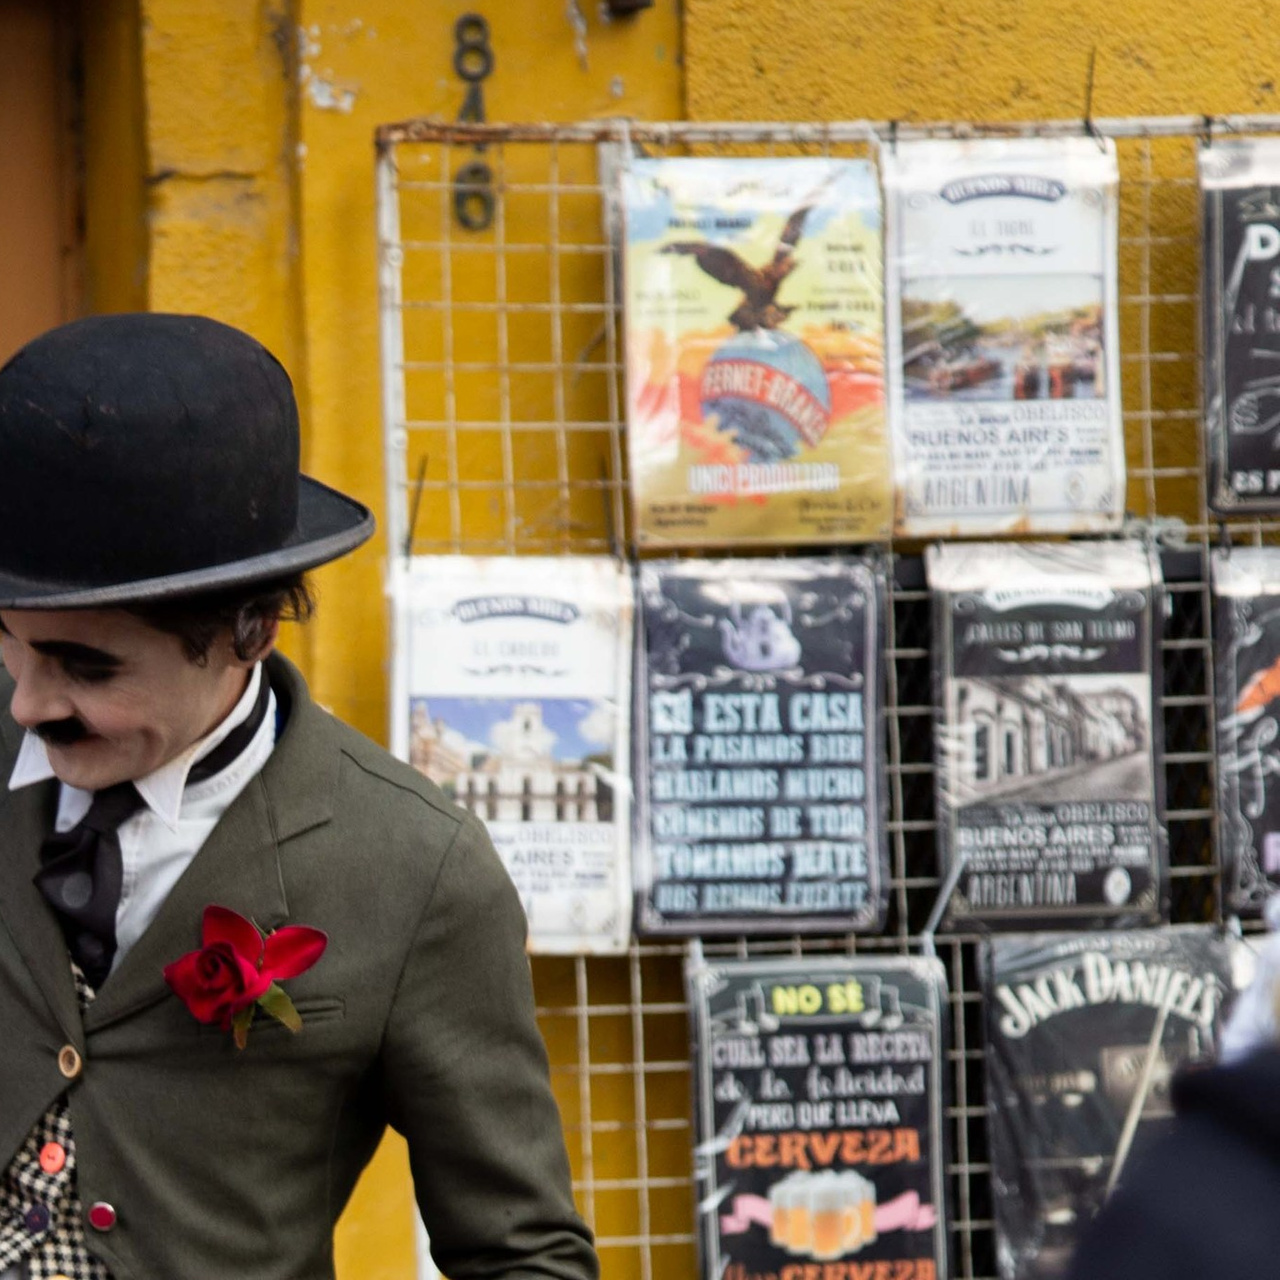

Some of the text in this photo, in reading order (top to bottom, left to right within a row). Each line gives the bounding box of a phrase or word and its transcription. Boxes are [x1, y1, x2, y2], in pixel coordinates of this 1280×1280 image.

[910, 427, 1001, 447] BUENOS
[1007, 426, 1070, 445] AIRES
[923, 476, 1033, 508] ARGENTINA
[703, 693, 782, 732] ESTA
[790, 692, 864, 732] CASA
[653, 734, 864, 763] LA PASAMOS BIEN
[653, 768, 865, 799] HABLAMOS MUCHO
[654, 804, 865, 838] COMEMOS DE TODO
[1056, 803, 1150, 823] OBELISCO
[957, 825, 1047, 847] BUENOS
[1048, 823, 1115, 846] AIRES
[512, 850, 573, 865] AIRES
[656, 843, 786, 879] TOMAMOS
[792, 842, 868, 878] MATE
[656, 883, 698, 913] NOS
[787, 881, 869, 910] FUERTE
[968, 872, 1077, 907] ARGENTINA
[772, 976, 865, 1015] NO SÉ
[997, 967, 1086, 1039] JACK
[713, 1031, 934, 1068] CUAL SEA LA RECETA
[807, 1064, 926, 1101] felicidad
[744, 1099, 901, 1130] PERO QUE LLEVA
[724, 1127, 920, 1171] CERVEZA
